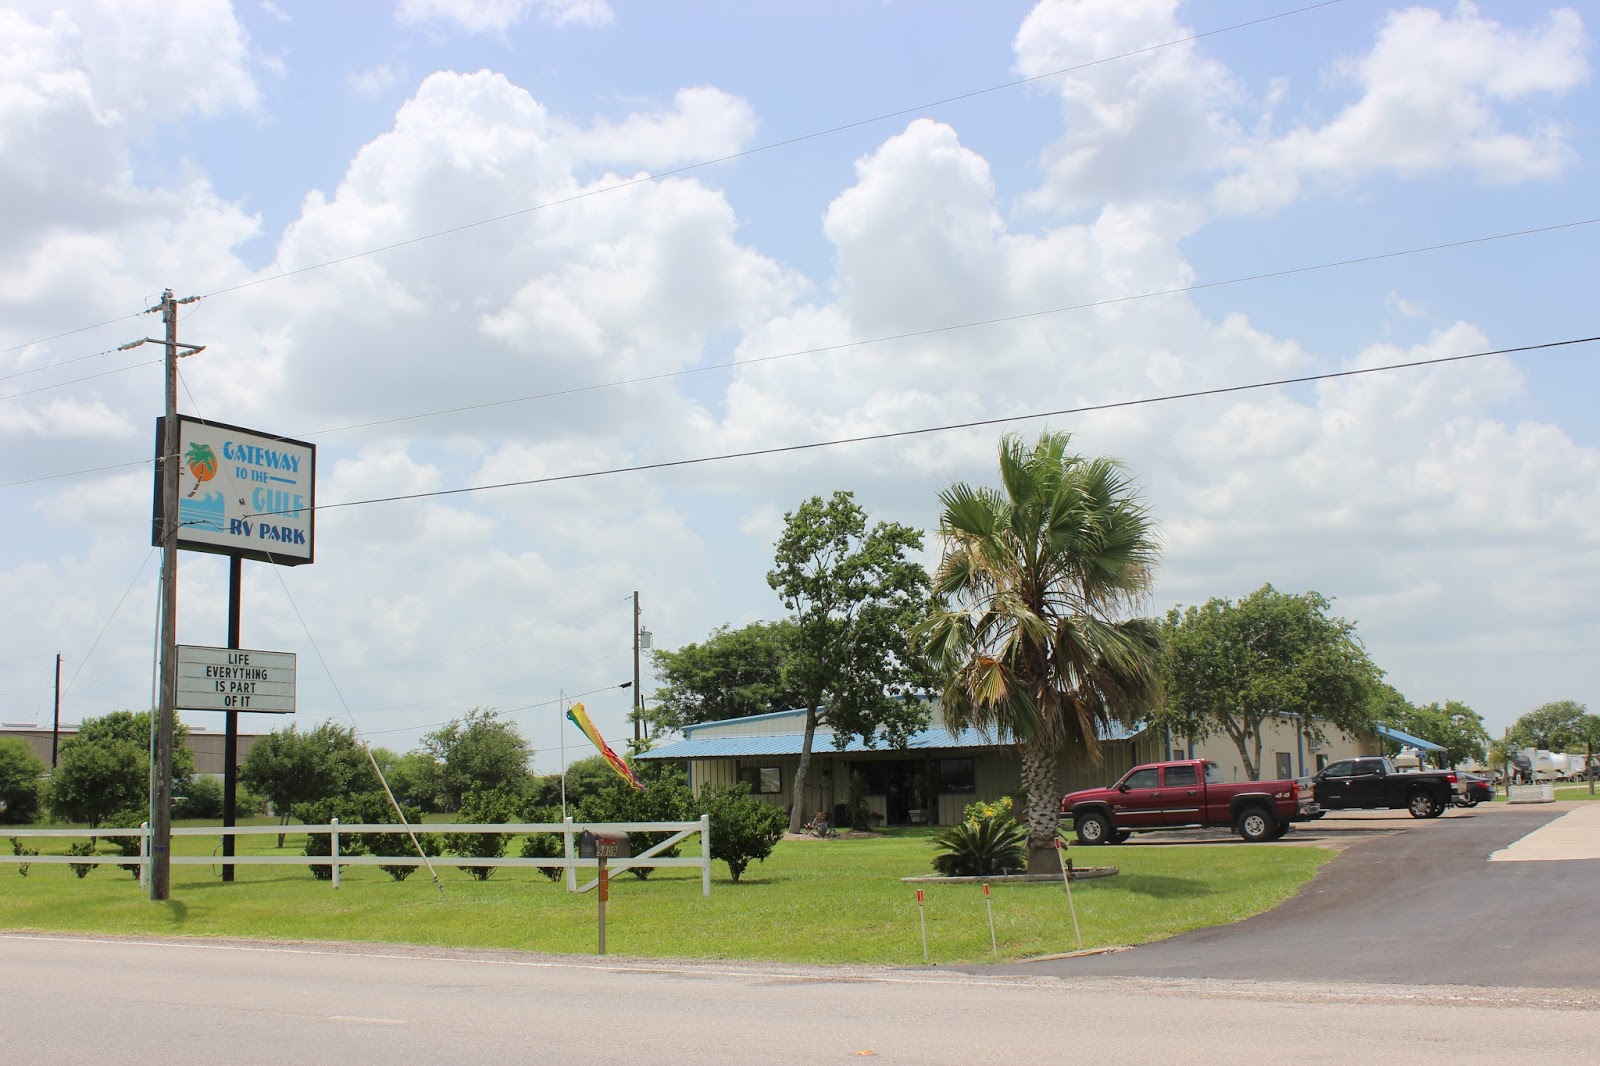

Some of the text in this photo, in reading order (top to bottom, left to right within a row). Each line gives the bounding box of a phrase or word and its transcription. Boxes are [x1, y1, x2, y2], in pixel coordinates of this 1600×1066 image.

[223, 441, 300, 473] GATEWAY
[235, 466, 269, 484] TO THE
[252, 487, 303, 519] GULF
[230, 518, 306, 545] RV PARK
[228, 653, 250, 665] LIFE
[206, 665, 268, 680] EVERYTHING
[215, 680, 256, 693] IS PART
[224, 695, 251, 707] OF IT
[597, 846, 617, 856] 9809
